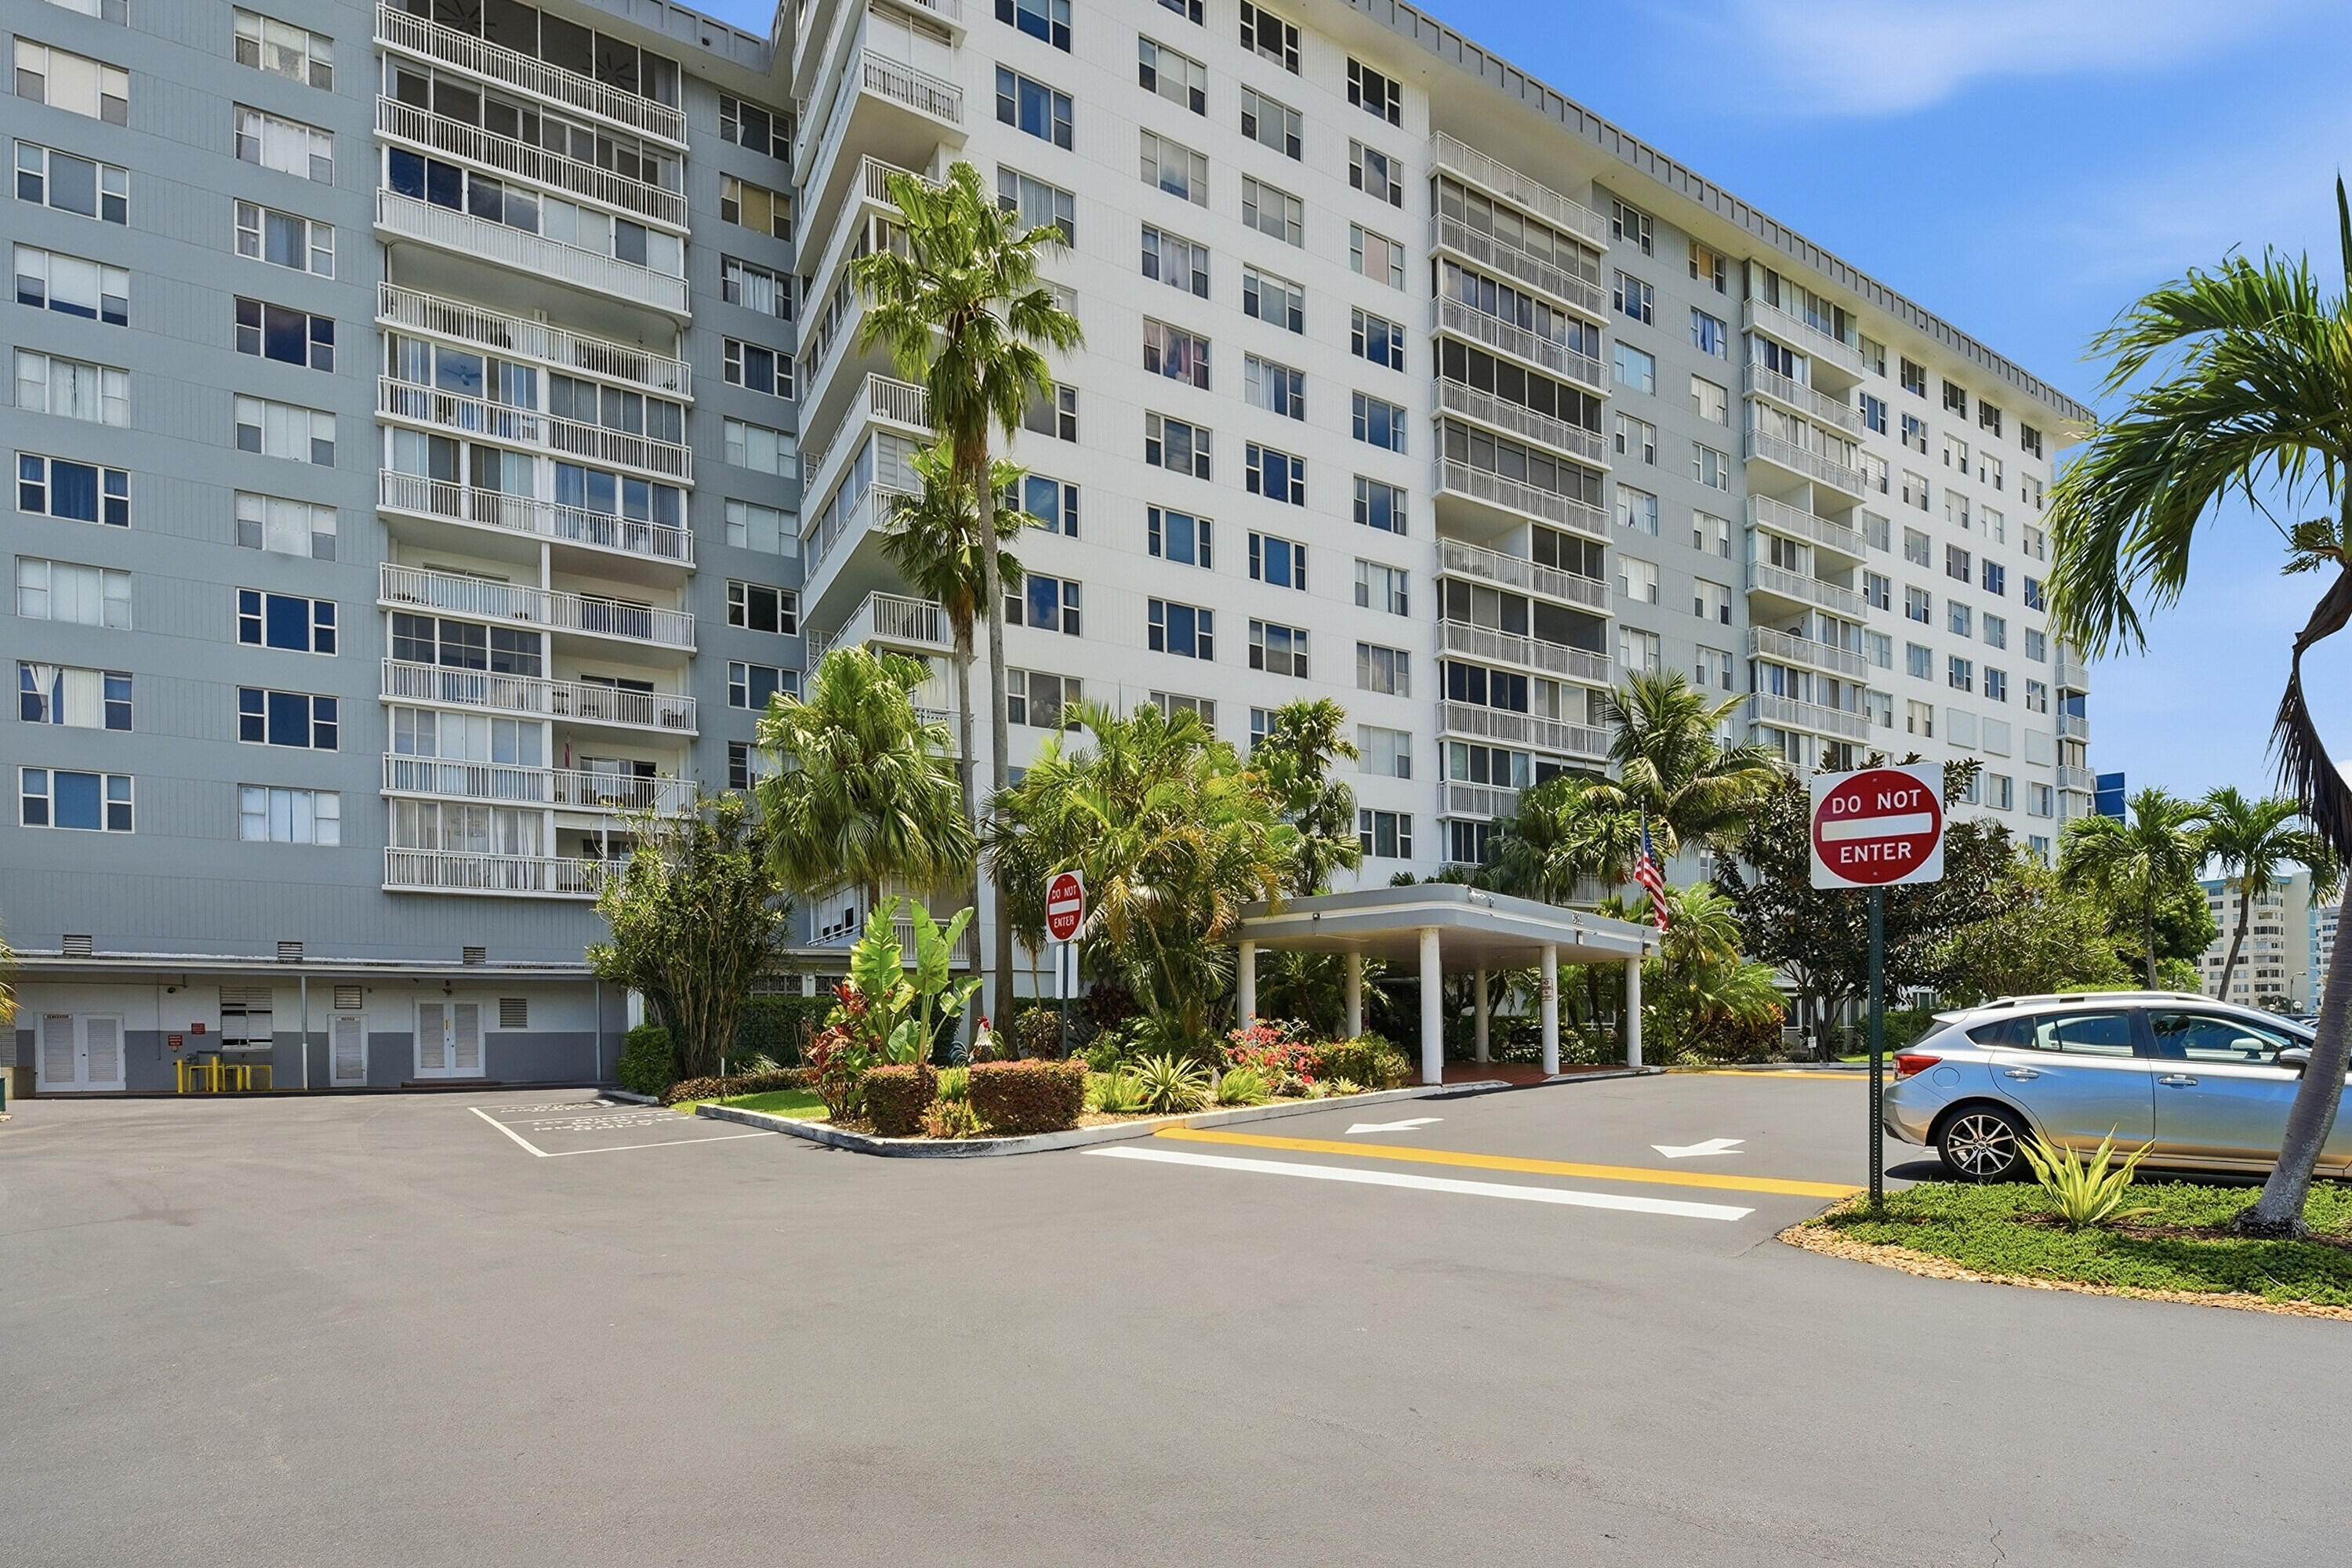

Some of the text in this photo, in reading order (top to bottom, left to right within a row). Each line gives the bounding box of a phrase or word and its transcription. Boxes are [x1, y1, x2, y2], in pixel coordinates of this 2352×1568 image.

[1832, 789, 1922, 815] DO NOT
[1840, 841, 1911, 864] ENTER
[1051, 884, 1077, 900] DO NOT
[1054, 915, 1074, 928] ENTER
